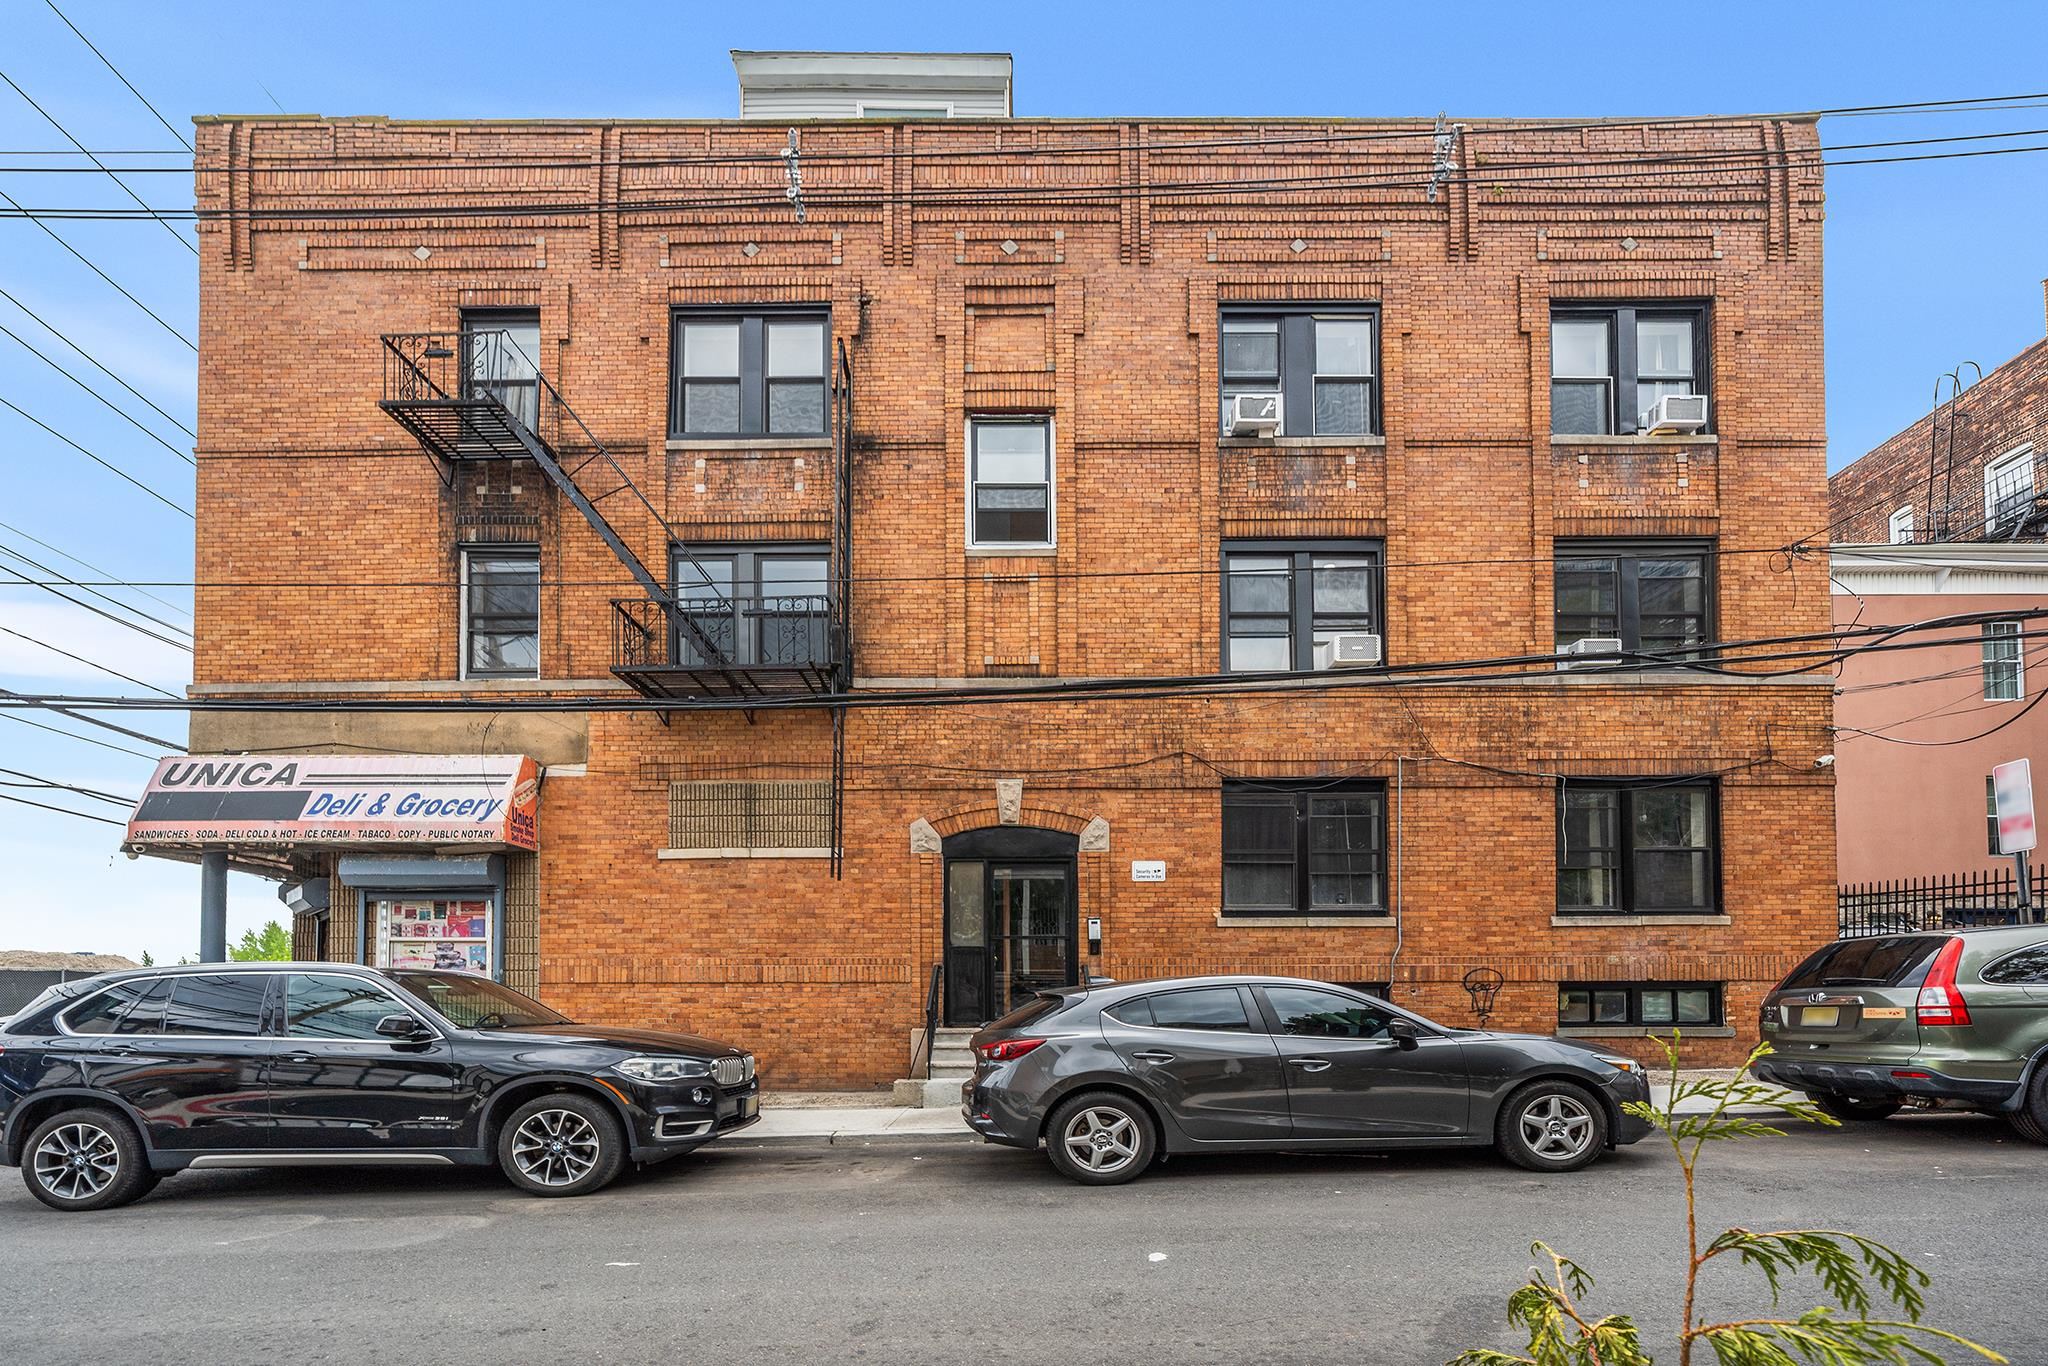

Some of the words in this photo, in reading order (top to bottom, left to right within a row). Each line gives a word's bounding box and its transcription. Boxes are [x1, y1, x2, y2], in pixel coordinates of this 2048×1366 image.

[161, 762, 299, 786] UNICA
[306, 792, 368, 816] Deli
[366, 792, 391, 816] &
[395, 792, 504, 823] Grocery
[511, 806, 534, 829] Unica
[134, 830, 189, 839] SANDWICHES
[195, 830, 218, 839] SODA
[225, 829, 244, 838] DELI
[246, 829, 269, 838] COLD
[271, 829, 277, 838] &
[279, 829, 298, 838] HOT
[304, 829, 318, 838] ICE
[320, 829, 350, 838] CREAM
[358, 829, 391, 838] TABACO
[398, 829, 421, 838] COPY
[428, 829, 459, 838] PUBLIC
[461, 829, 495, 838] NOTARY
